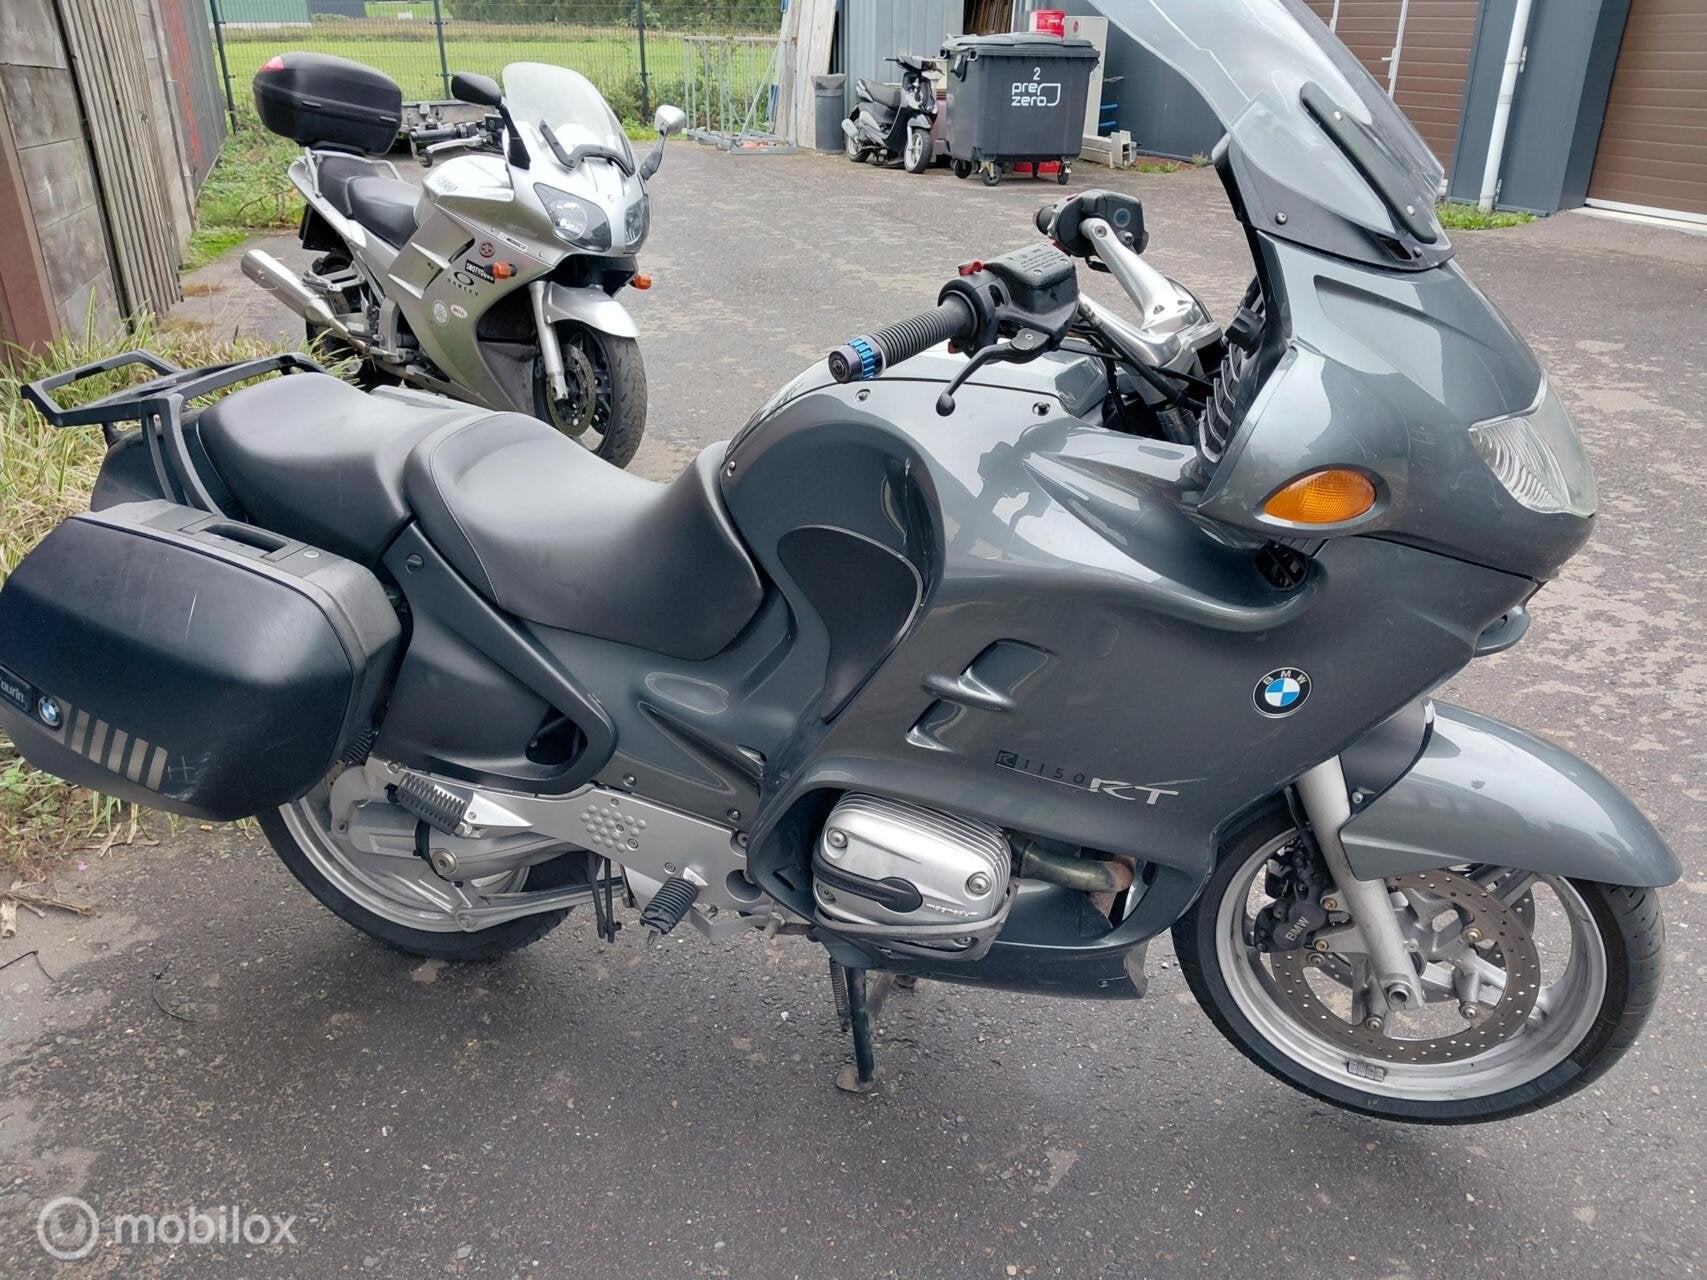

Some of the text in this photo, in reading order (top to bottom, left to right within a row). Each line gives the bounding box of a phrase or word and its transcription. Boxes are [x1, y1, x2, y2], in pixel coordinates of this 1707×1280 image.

[1033, 66, 1041, 80] 2
[1012, 82, 1038, 95] pre
[1011, 96, 1047, 107] zero
[1262, 669, 1308, 686] BMW
[1023, 759, 1086, 785] 1150
[1089, 777, 1180, 806] RT
[1284, 915, 1310, 942] BMW
